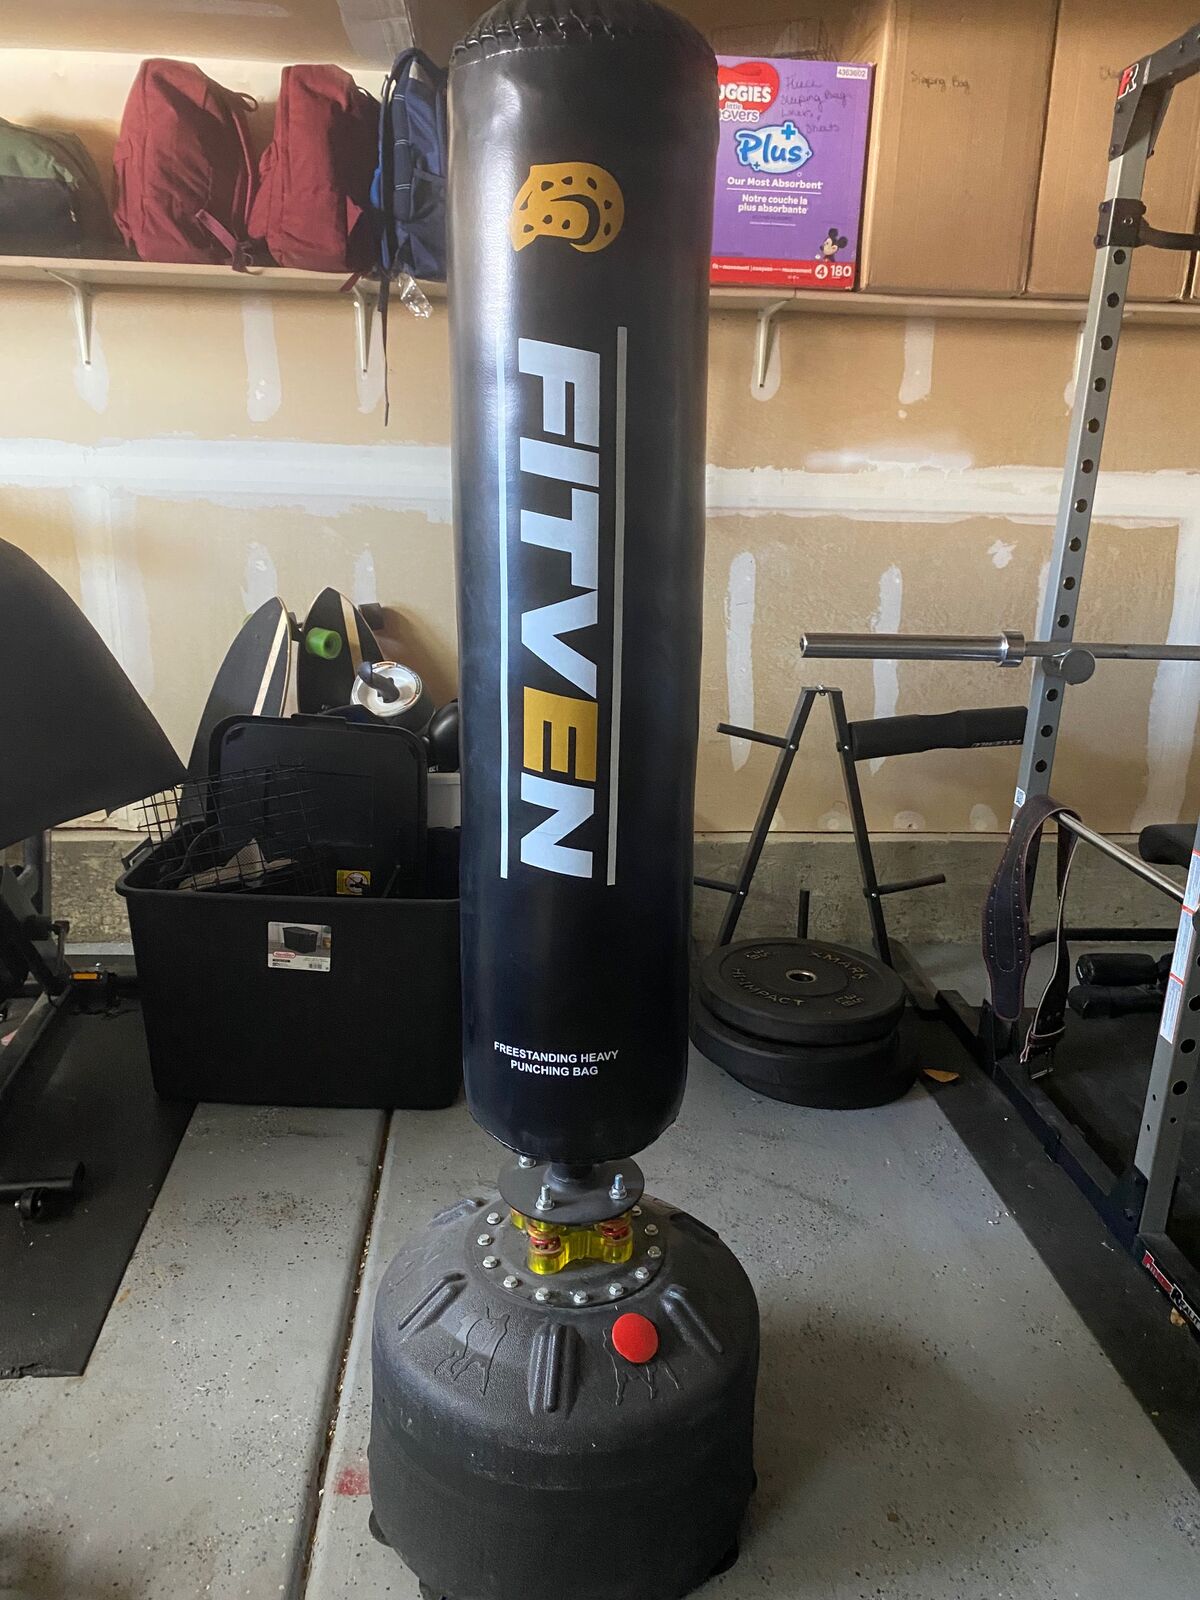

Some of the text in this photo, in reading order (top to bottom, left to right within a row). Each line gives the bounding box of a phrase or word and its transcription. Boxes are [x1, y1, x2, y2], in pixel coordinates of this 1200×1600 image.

[719, 83, 772, 103] UGGIES
[719, 109, 759, 121] overs
[738, 133, 802, 164] Plus
[727, 176, 746, 186] Our
[747, 177, 770, 187] Most
[742, 194, 808, 205] Notre couche la
[738, 203, 808, 215] plus absorbante
[830, 264, 852, 277] 180
[518, 337, 600, 878] FITVEN
[493, 1040, 619, 1064] FREESTANDING HEAVY
[510, 1059, 599, 1077] PUNCHING BAG
